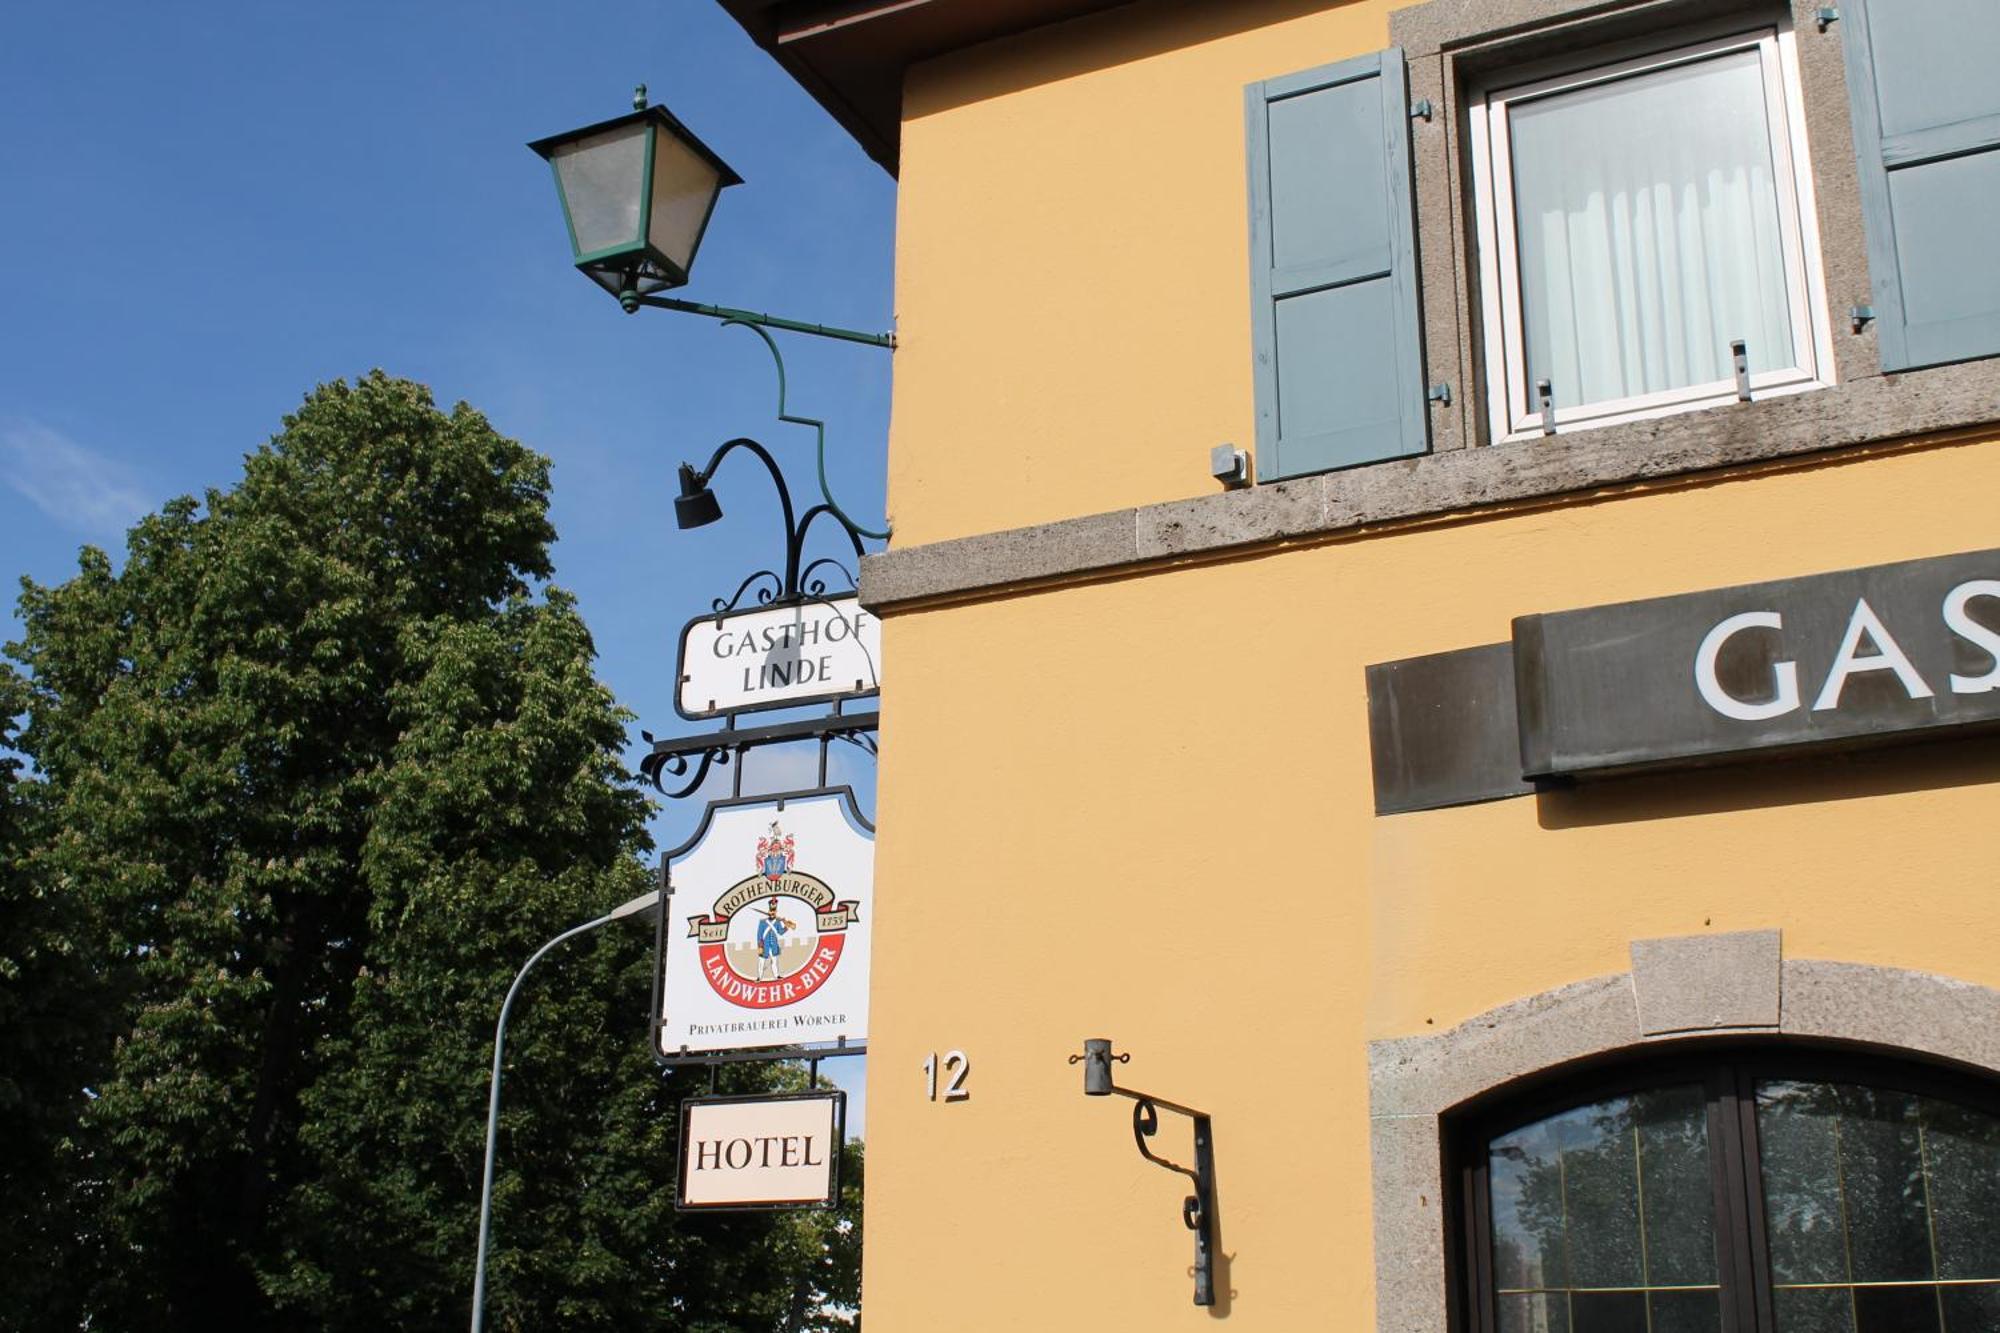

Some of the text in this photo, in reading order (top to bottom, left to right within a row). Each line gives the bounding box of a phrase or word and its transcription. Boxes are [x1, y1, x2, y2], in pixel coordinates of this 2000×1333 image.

[712, 612, 867, 659] GASTHOF
[1694, 579, 2000, 721] GAS
[743, 655, 832, 692] LINDE
[722, 879, 824, 915] ROTHENBURGER
[702, 926, 723, 938] Seit
[706, 946, 836, 1004] LANDWEHR-BIER
[921, 1050, 970, 1102] 12
[695, 1135, 822, 1171] HOTEL
